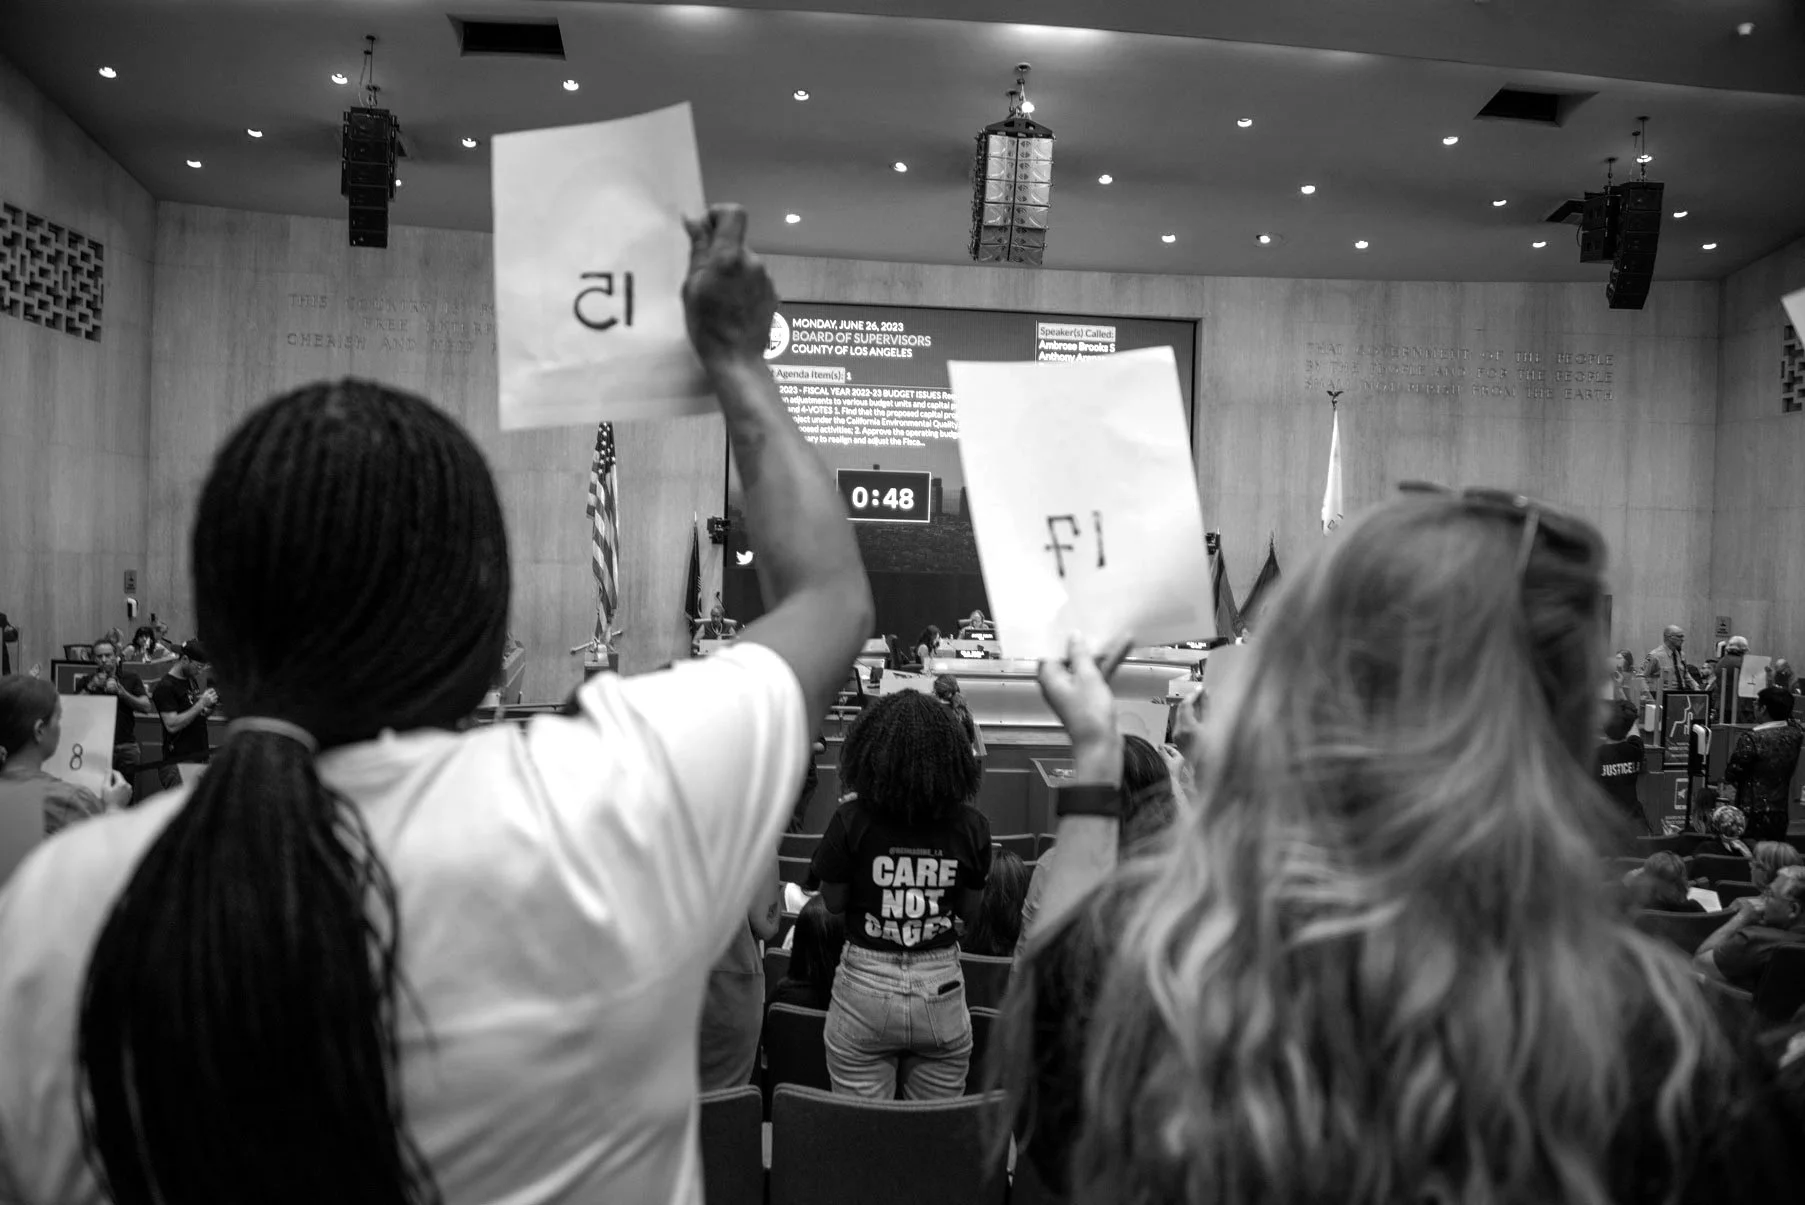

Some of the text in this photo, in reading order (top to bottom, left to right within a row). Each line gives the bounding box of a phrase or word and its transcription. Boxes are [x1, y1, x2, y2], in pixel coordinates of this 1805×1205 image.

[288, 293, 328, 309] THIS
[363, 316, 409, 332] FREE
[792, 318, 905, 333] MONDAY, JUNE 26, 2023
[792, 330, 932, 347] BOARD OF SUPERVISORS
[1040, 326, 1115, 339] Speaker(s) Called:
[286, 332, 367, 351] CHERISH
[1038, 339, 1116, 353] Ambrose Brooks S
[791, 343, 913, 359] COUNTY OF LOS ANGELES
[1515, 350, 1542, 364] THE
[1556, 352, 1614, 366] PEOPLE
[776, 369, 810, 380] Agenda
[811, 370, 844, 381] Item(s):
[846, 371, 852, 381] 1
[1476, 367, 1508, 380] FOR
[1517, 368, 1547, 382] THE
[1556, 370, 1614, 383] PEOPLE
[779, 385, 798, 395] 2023
[803, 386, 829, 396] FISCAL
[830, 387, 851, 397] YEAR
[851, 387, 882, 398] 2022-23
[882, 389, 915, 399] BUDGET
[915, 390, 942, 400] ISSUES
[1472, 384, 1517, 399] FROM
[1527, 386, 1553, 400] THE
[1564, 387, 1614, 402] EARTH
[790, 396, 833, 405] adjustments
[833, 397, 842, 405] to
[842, 398, 869, 407] various
[869, 398, 894, 409] budget
[894, 400, 912, 409] units
[913, 401, 927, 409] and
[927, 401, 950, 411] capital
[801, 405, 834, 415] 4-VOTES
[841, 407, 857, 416] Find
[858, 407, 873, 416] that
[873, 408, 886, 417] the
[886, 409, 920, 419] proposed
[920, 410, 944, 420] capital
[811, 416, 833, 425] under
[833, 416, 846, 425] the
[846, 416, 881, 426] California
[881, 418, 932, 428] Environmental
[932, 419, 958, 430] Quality
[819, 435, 828, 444] to
[828, 435, 853, 446] realign
[853, 436, 867, 445] and
[867, 436, 889, 446] adjust
[889, 437, 902, 446] the
[854, 426, 861, 435] 2.
[862, 426, 892, 437] Approve
[892, 428, 905, 437] the
[905, 429, 939, 440] operating
[851, 486, 915, 511] 0:48
[69, 743, 83, 771] 8
[872, 855, 959, 888] CARE
[881, 888, 945, 919] NOT
